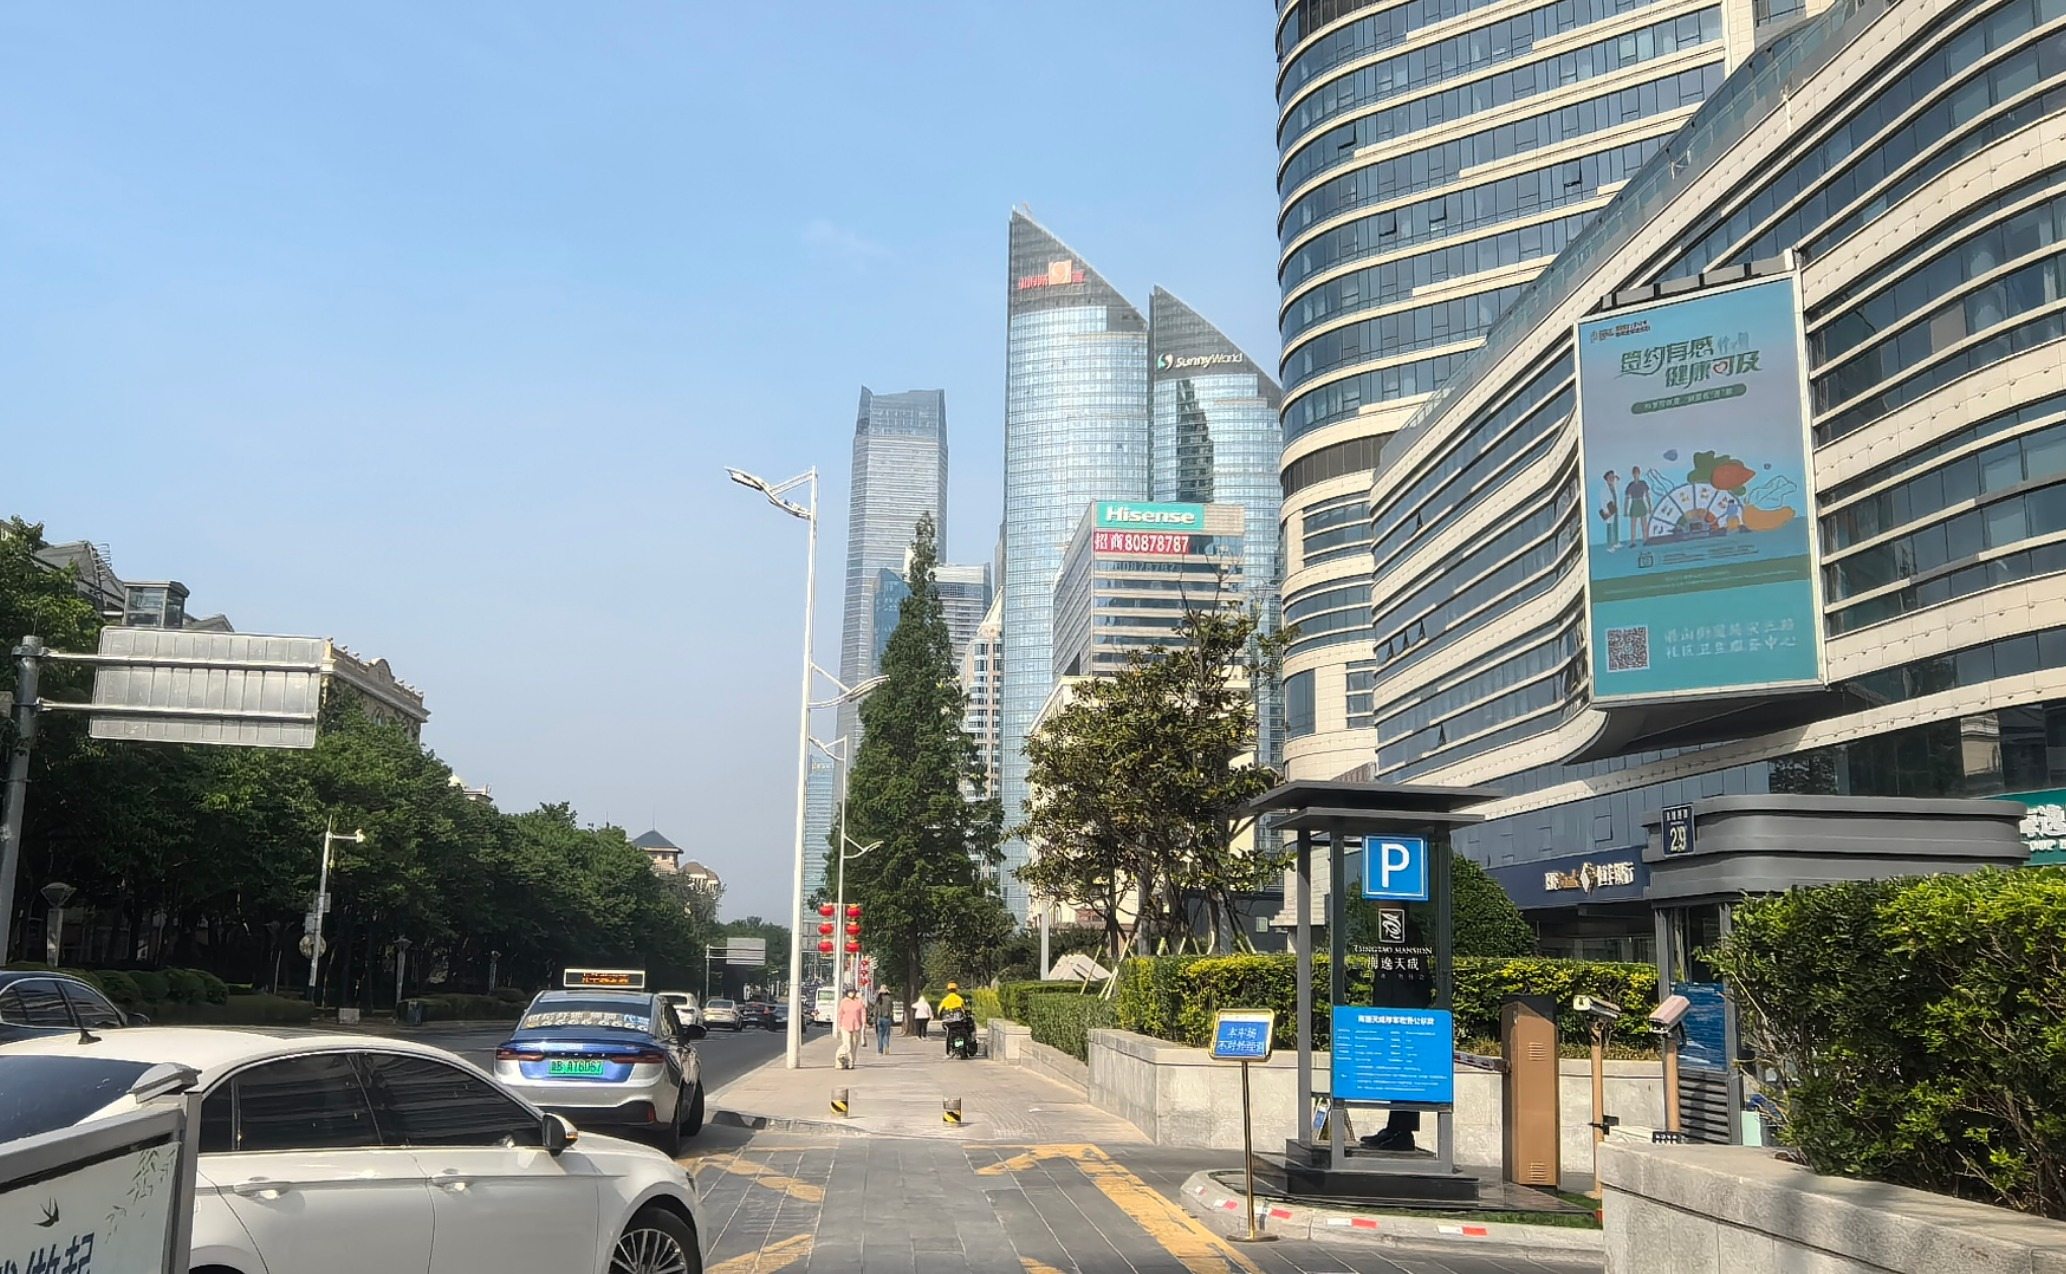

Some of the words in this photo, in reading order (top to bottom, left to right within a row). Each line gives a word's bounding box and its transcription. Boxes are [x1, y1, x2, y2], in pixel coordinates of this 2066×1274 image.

[1175, 352, 1244, 369] SunnyWorld
[1665, 350, 1763, 389] 健康可及
[1106, 505, 1196, 524] Hisense
[1669, 826, 1688, 851] 29
[1381, 843, 1410, 888] P
[1394, 945, 1433, 955] MANSION
